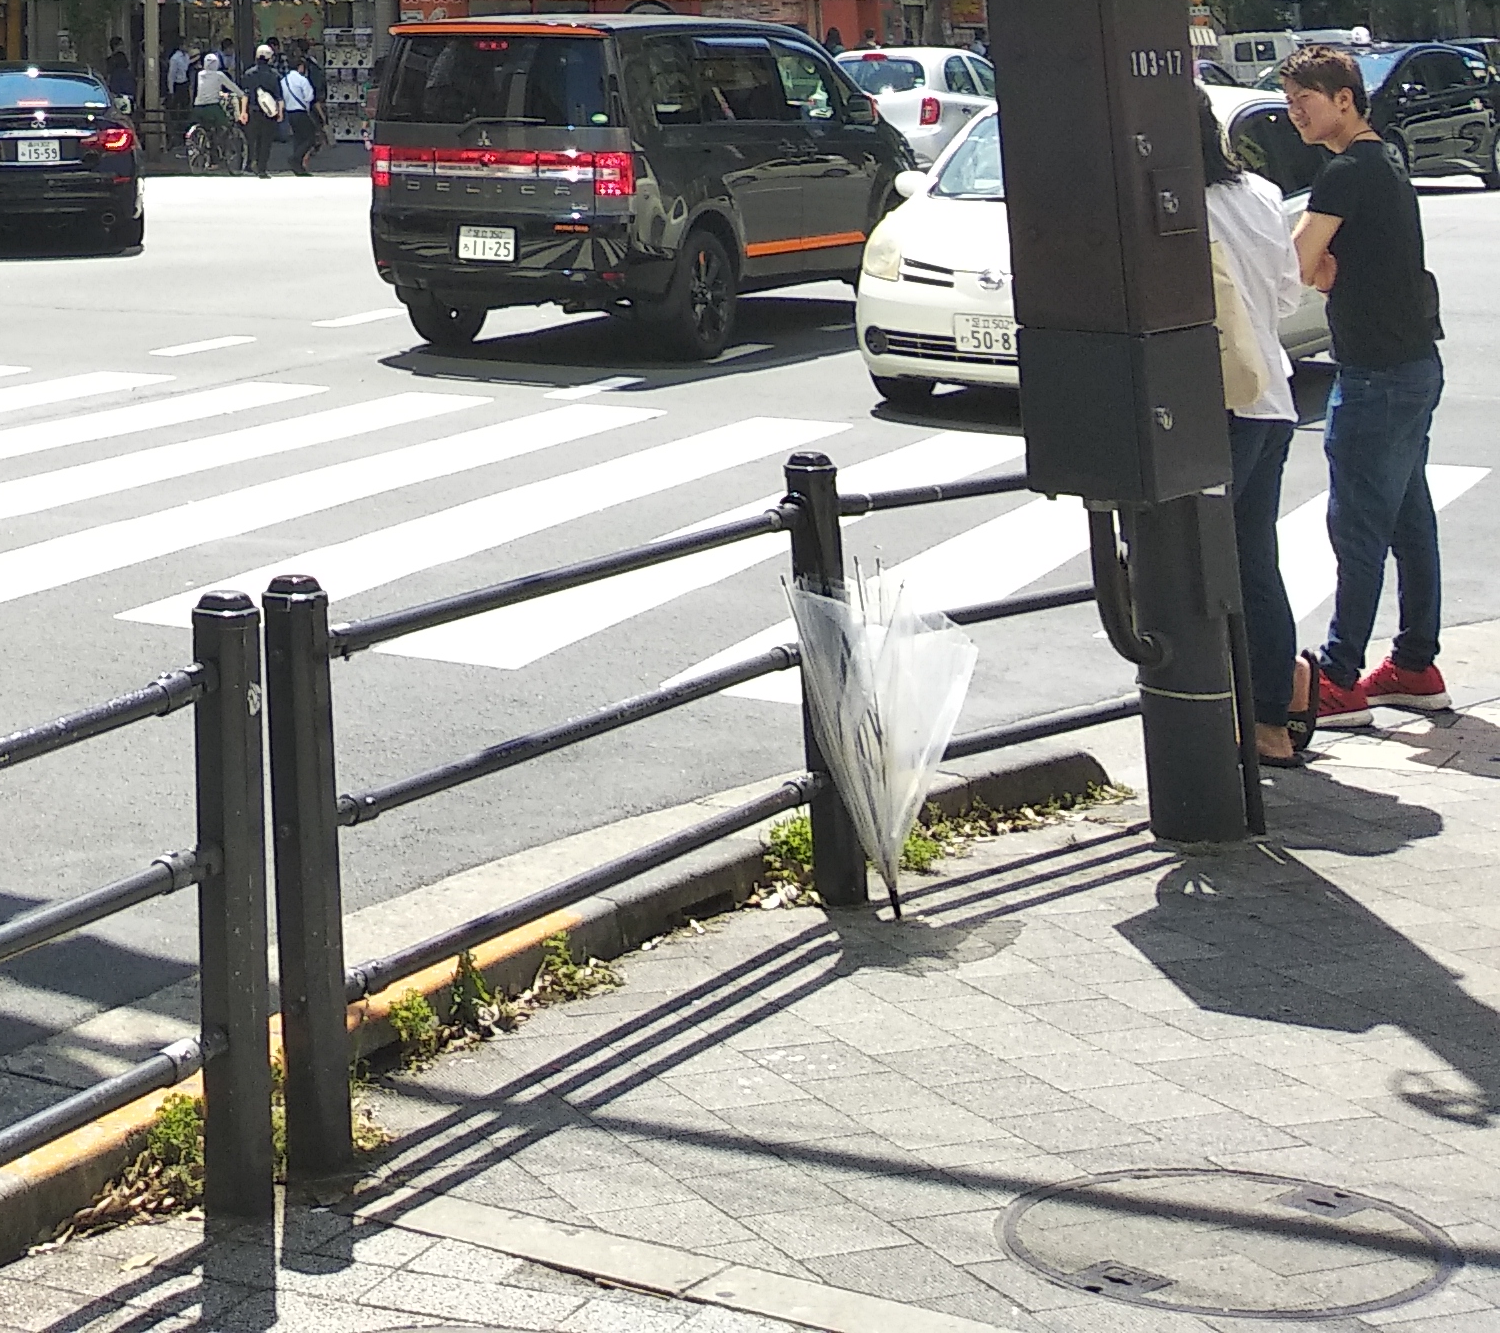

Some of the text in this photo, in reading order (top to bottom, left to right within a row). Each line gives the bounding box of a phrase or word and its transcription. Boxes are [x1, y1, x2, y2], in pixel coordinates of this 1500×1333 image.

[1130, 50, 1183, 77] 103-17
[28, 148, 58, 160] 15-59
[473, 239, 511, 258] 11-25
[971, 329, 1012, 351] 50-8
